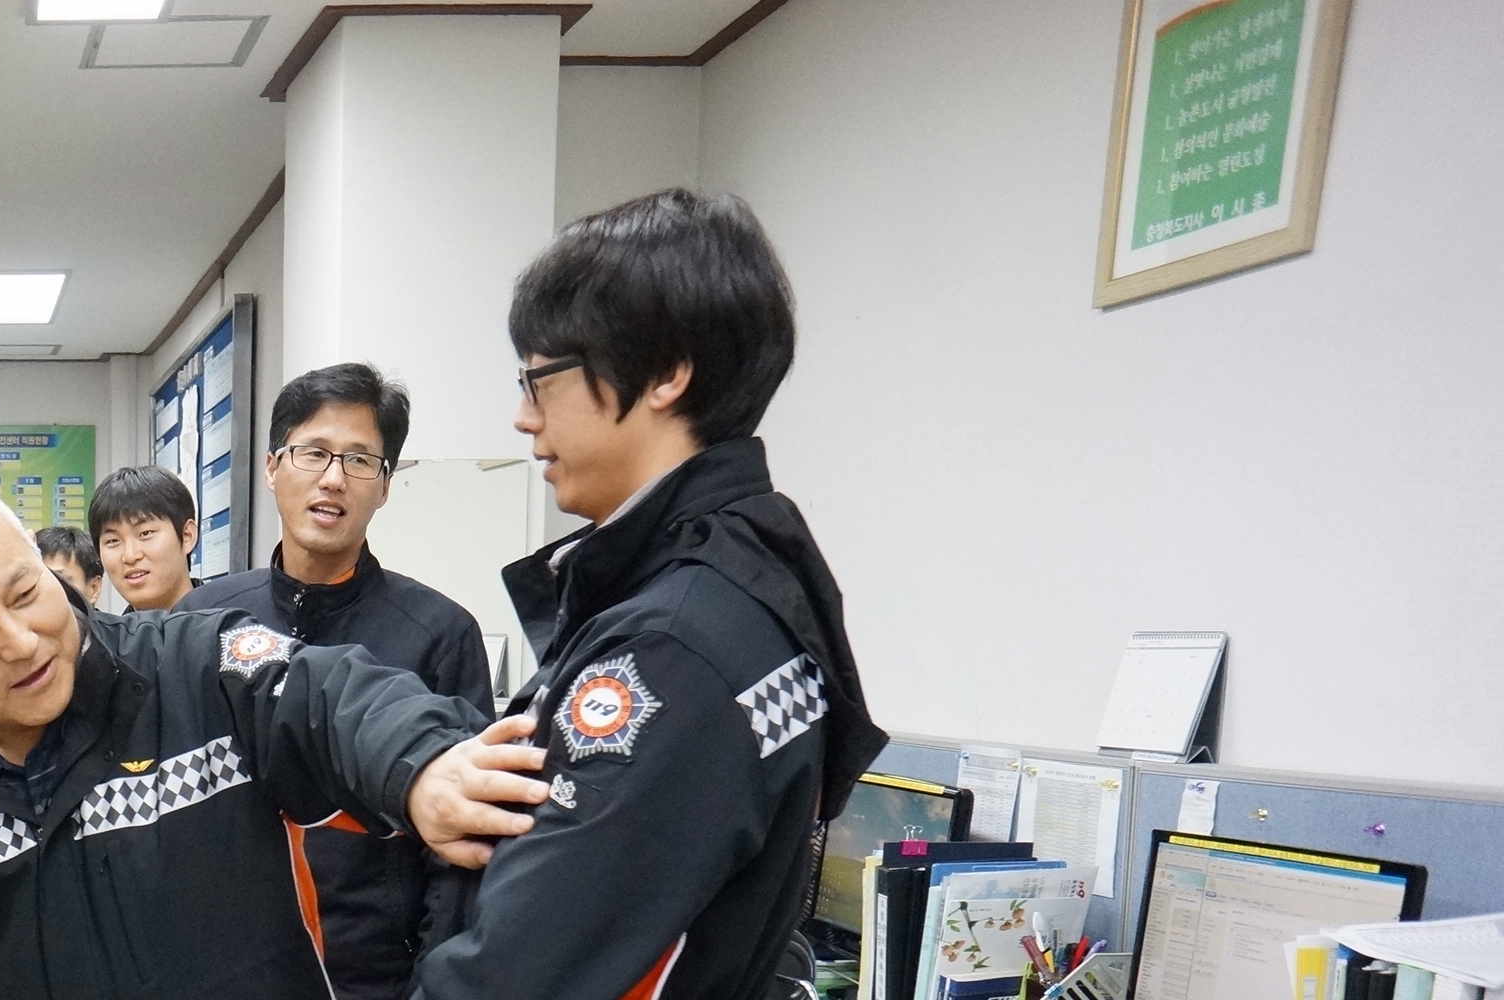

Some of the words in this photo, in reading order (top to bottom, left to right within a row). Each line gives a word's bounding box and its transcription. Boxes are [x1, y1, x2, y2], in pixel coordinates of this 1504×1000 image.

[1169, 162, 1213, 192] 참여하는
[1146, 211, 1205, 243] 충청북도지사
[583, 698, 619, 717] 119
